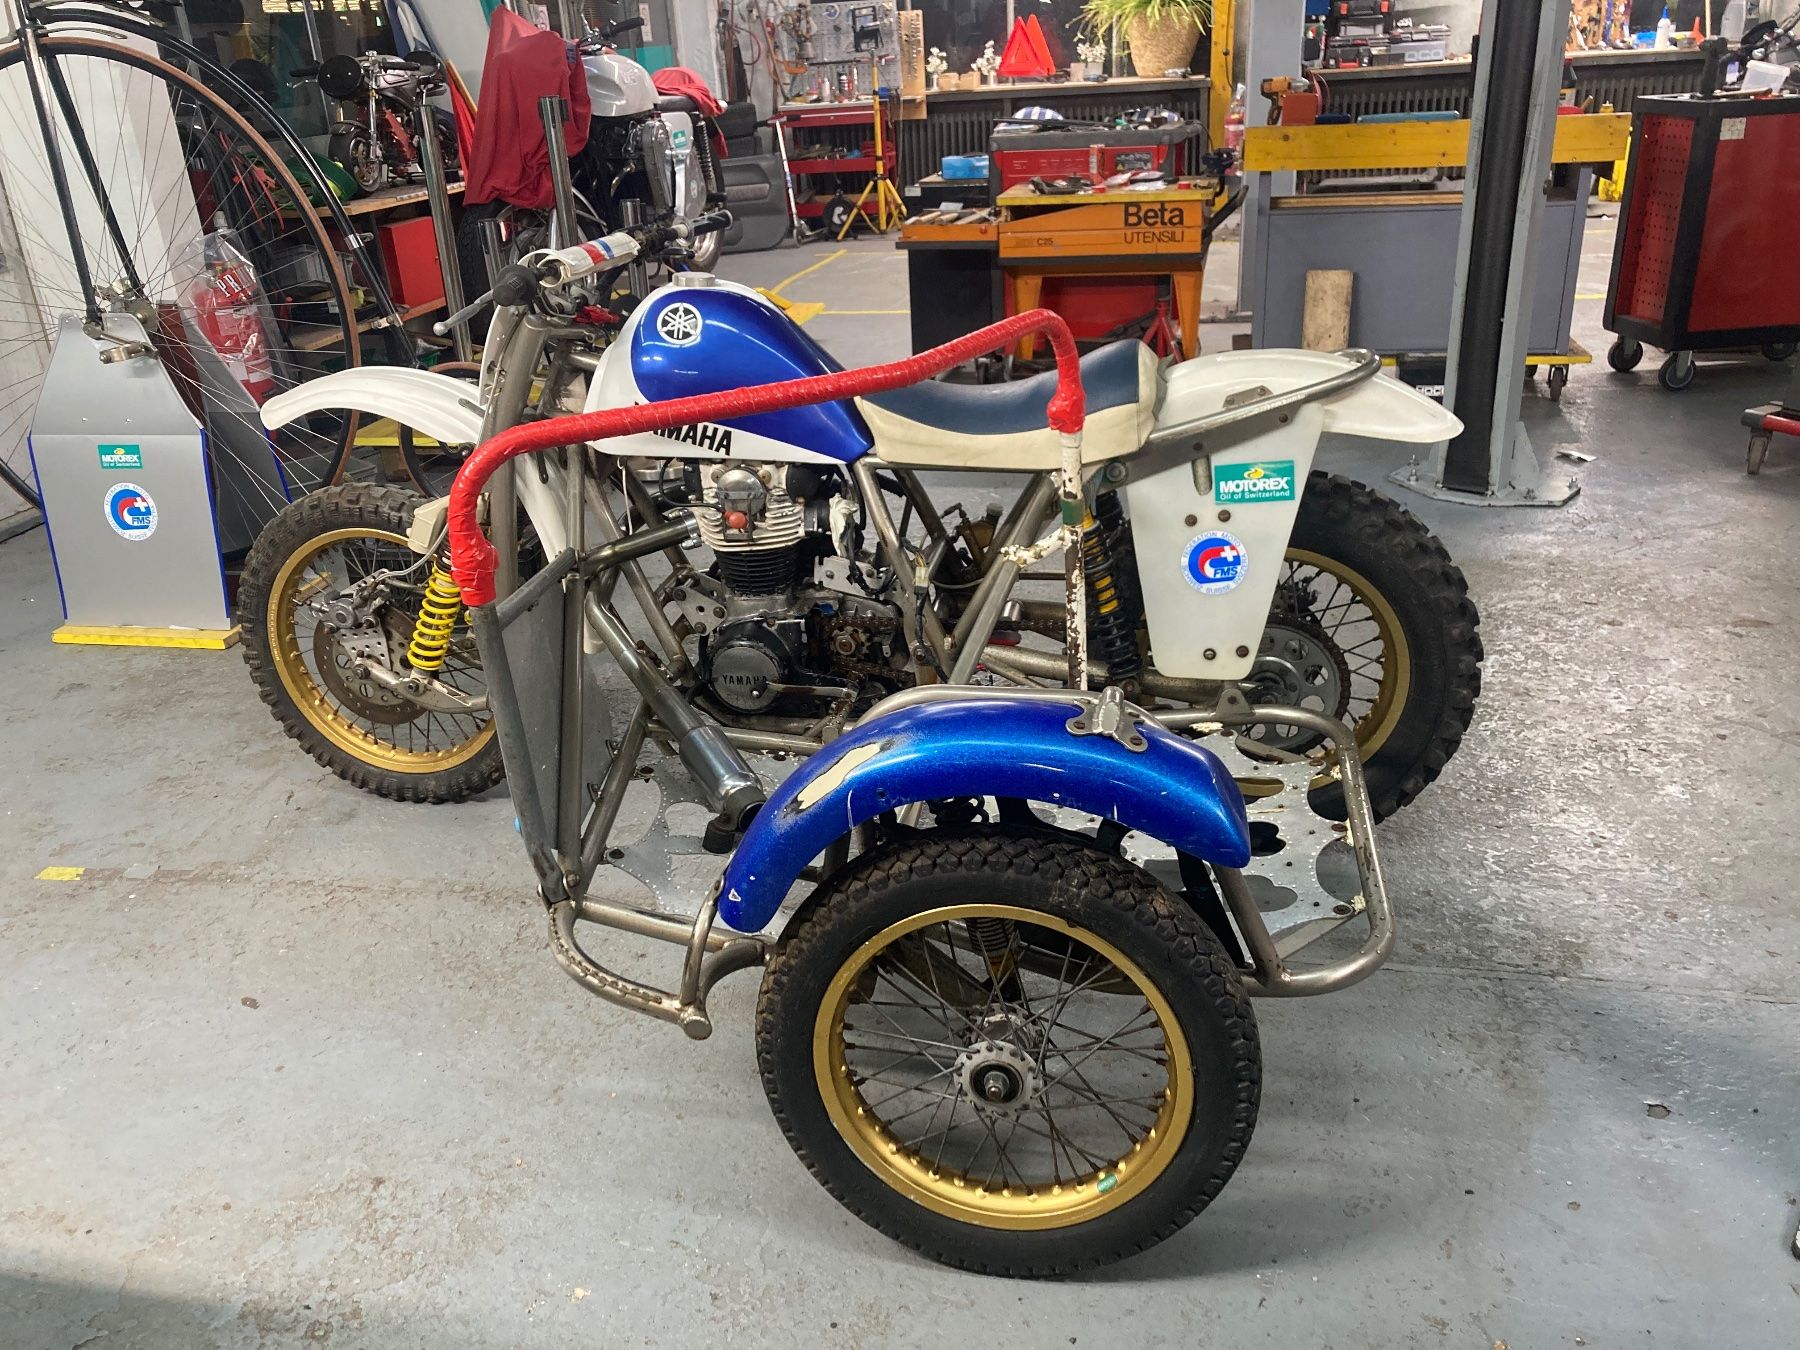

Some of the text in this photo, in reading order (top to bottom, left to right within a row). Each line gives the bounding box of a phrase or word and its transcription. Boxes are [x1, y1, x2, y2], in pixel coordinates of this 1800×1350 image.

[1124, 202, 1184, 227] Beta
[1124, 230, 1184, 244] UTENSILI
[101, 454, 140, 462] MOTOREX
[1219, 477, 1289, 493] MOTOREX
[1245, 490, 1290, 499] Switzerland
[131, 516, 151, 525] FMS
[1213, 567, 1238, 578] FMS
